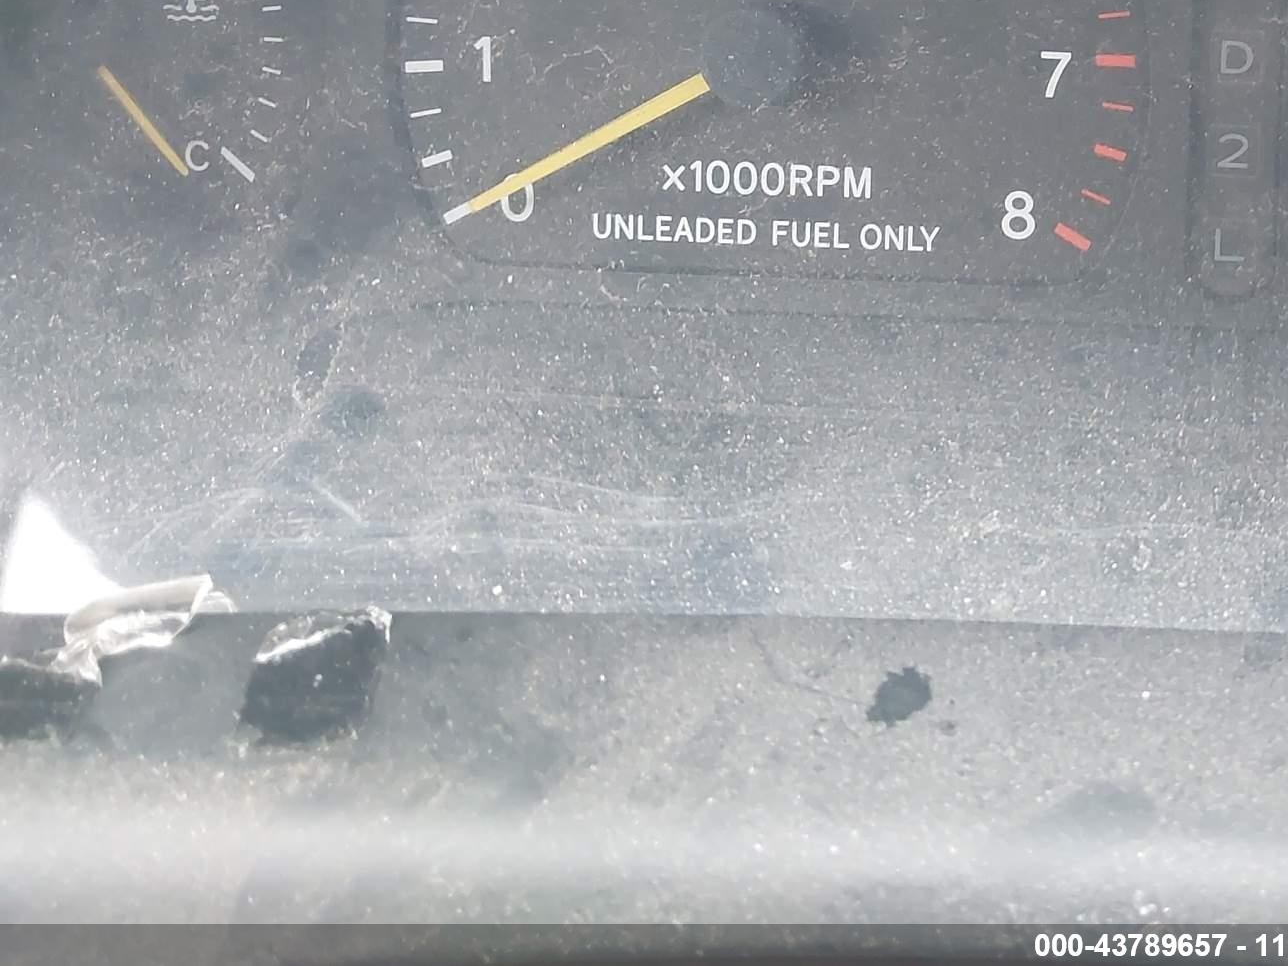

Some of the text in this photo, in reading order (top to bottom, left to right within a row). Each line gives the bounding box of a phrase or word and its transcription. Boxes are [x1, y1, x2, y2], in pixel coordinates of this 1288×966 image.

[474, 36, 492, 83] 1
[1040, 51, 1072, 98] 7
[1219, 40, 1255, 75] D
[184, 140, 210, 172] C
[1216, 133, 1250, 169] 2
[501, 173, 535, 222] 0
[662, 159, 873, 199] x1000RPM
[592, 212, 940, 252] UNLEADED FUEL ONLY
[1001, 190, 1036, 240] 8
[1213, 228, 1246, 263] L
